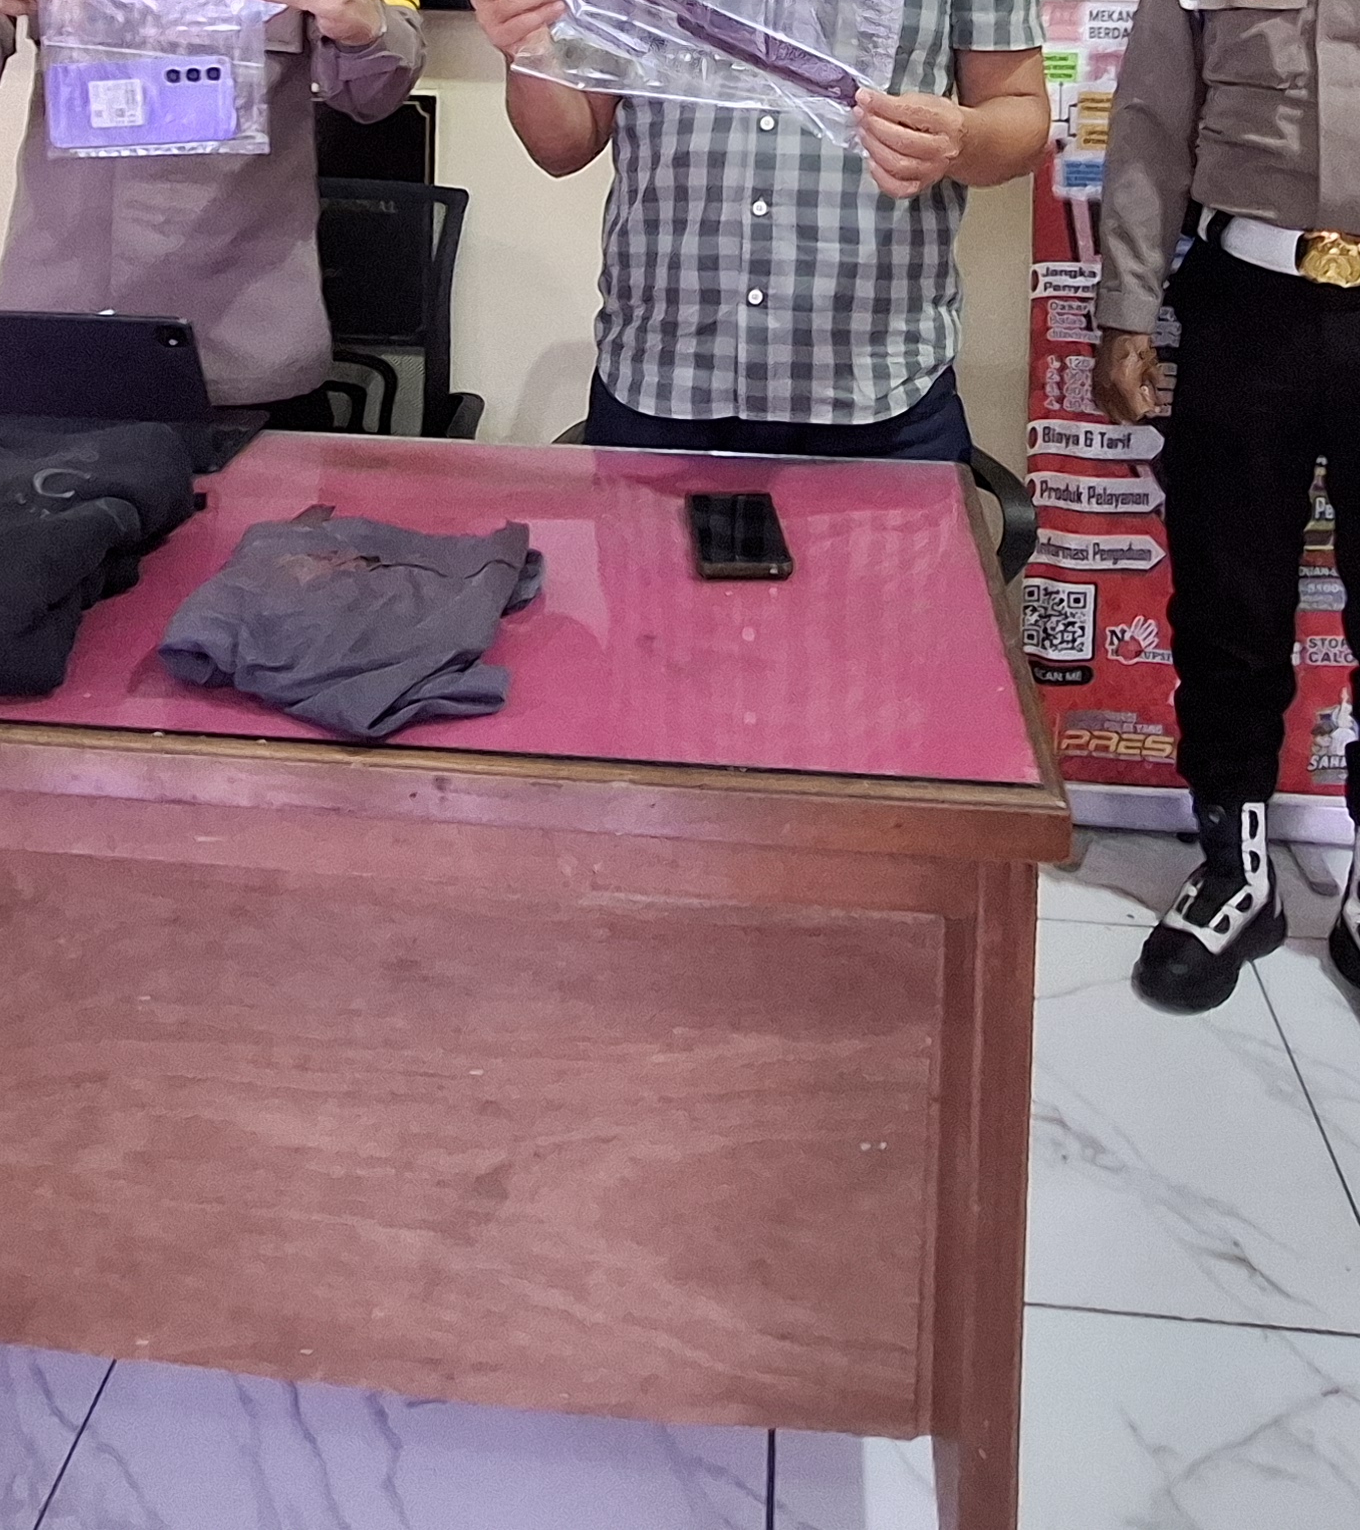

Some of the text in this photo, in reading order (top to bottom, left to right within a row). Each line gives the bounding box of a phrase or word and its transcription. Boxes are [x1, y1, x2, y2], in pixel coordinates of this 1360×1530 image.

[1041, 425, 1080, 450] Biaya
[1097, 431, 1133, 450] Tarif
[1040, 479, 1150, 509] Produk Pelayanan
